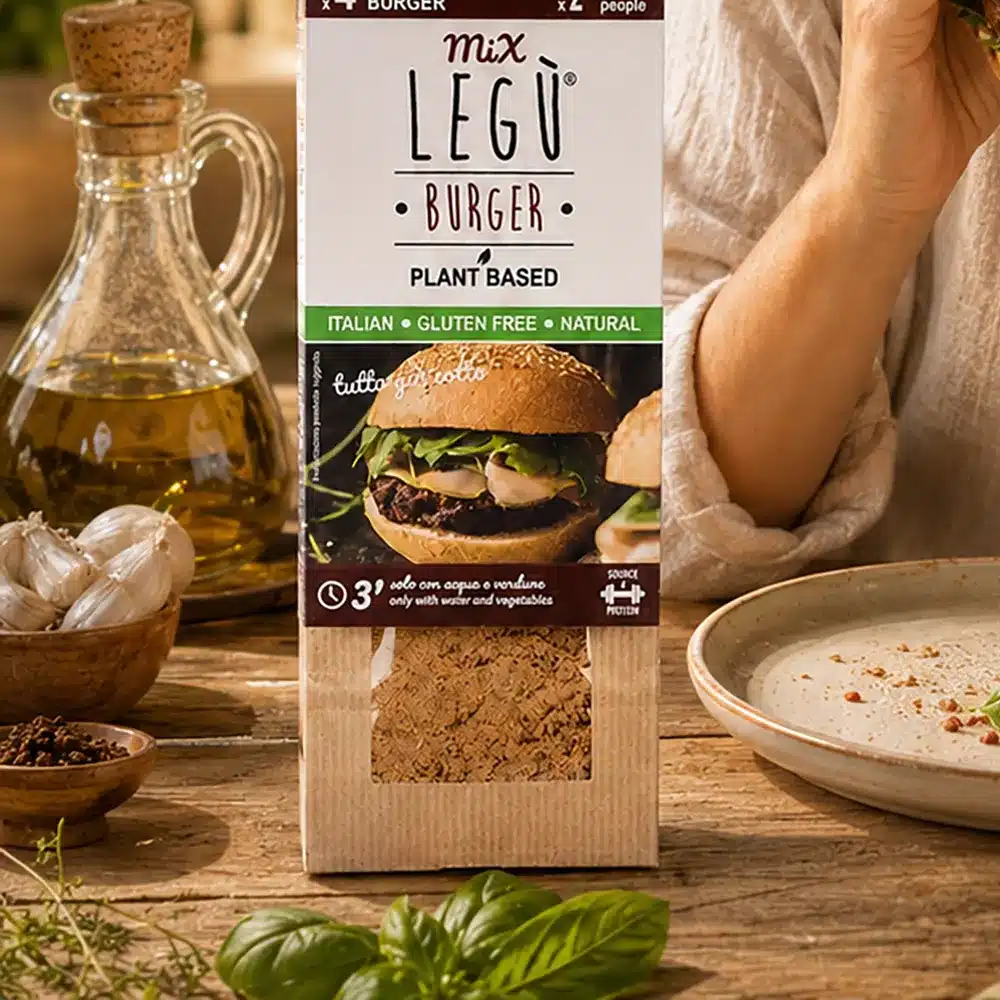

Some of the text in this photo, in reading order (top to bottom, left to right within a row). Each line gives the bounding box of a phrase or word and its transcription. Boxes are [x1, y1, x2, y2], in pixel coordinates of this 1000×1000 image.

[600, 0, 646, 15] people
[426, 183, 543, 231] BURGER
[411, 268, 558, 287] PLANT BASED
[327, 316, 640, 331] ITALIAN GLUTEN FREE NATURAL
[389, 594, 414, 609] only
[415, 595, 439, 605] with
[472, 594, 493, 605] and
